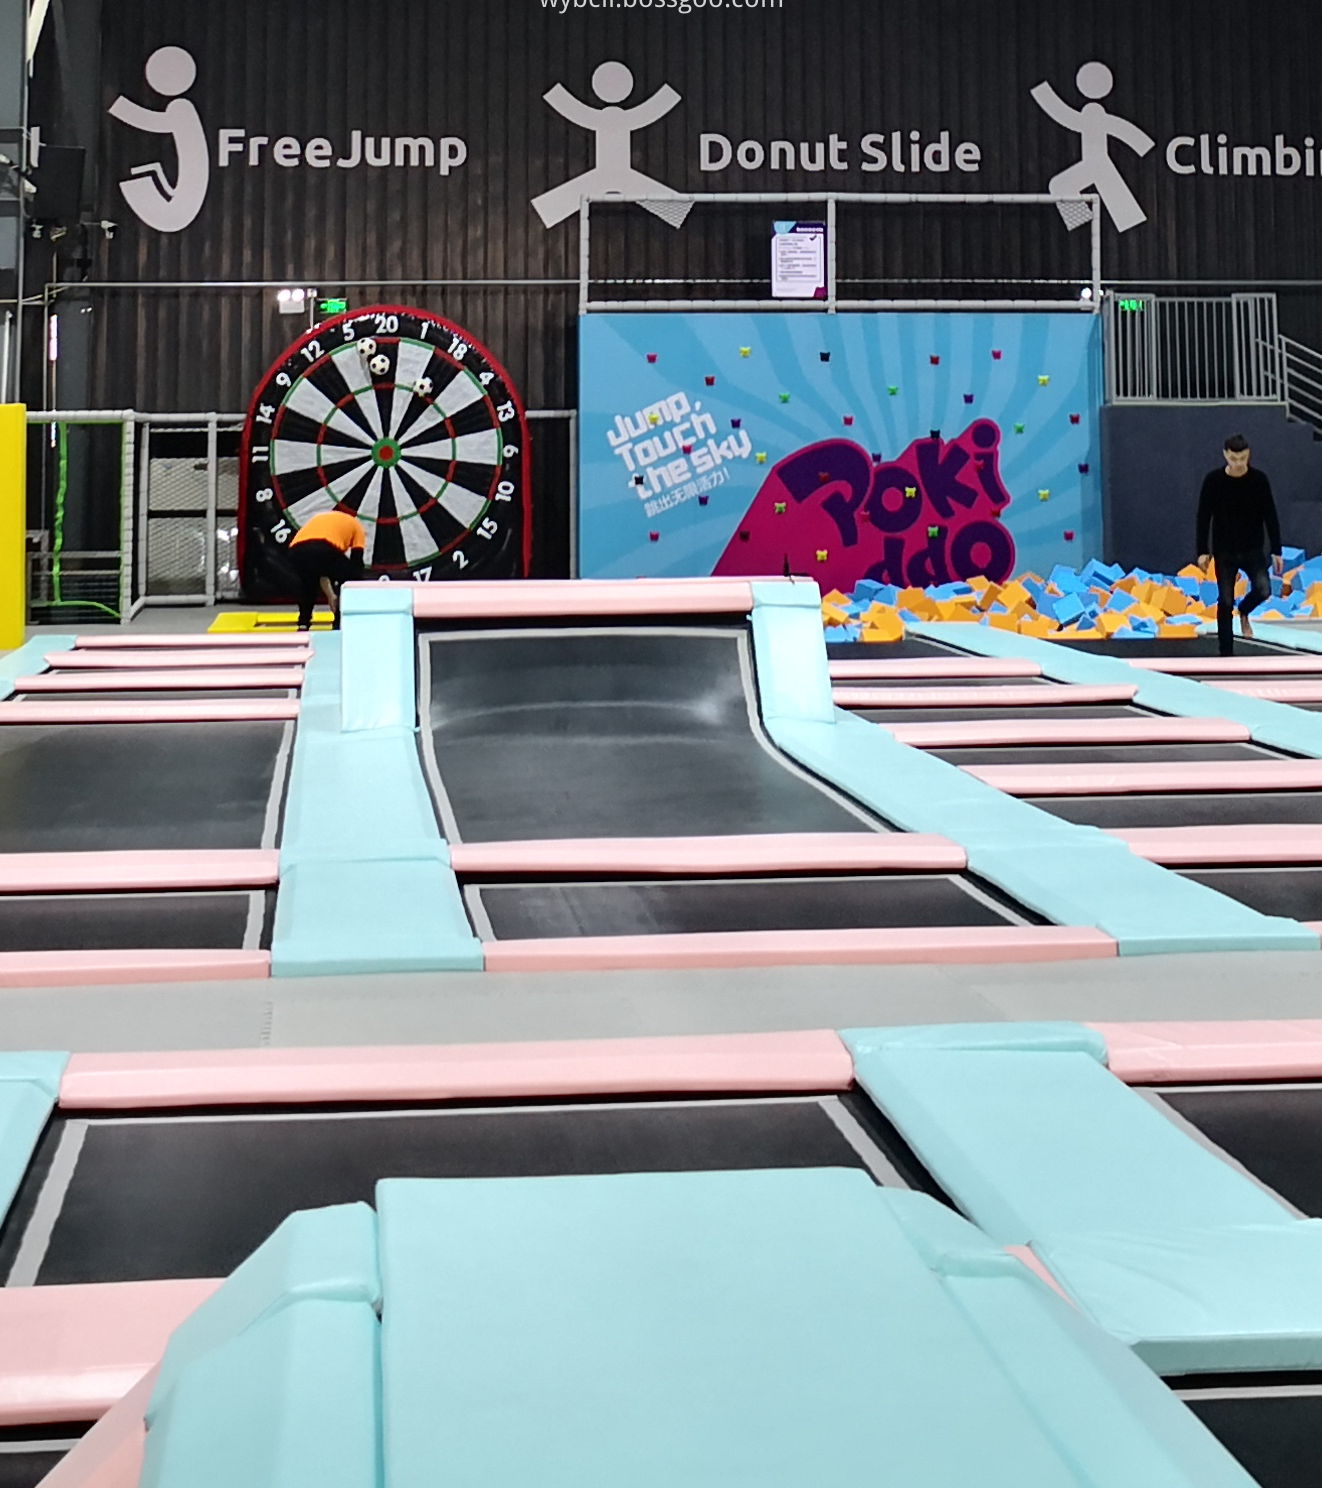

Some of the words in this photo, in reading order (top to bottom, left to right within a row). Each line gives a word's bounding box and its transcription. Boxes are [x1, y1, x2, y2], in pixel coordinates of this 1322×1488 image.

[698, 132, 850, 172] Donut
[859, 129, 982, 173] Slide
[342, 323, 355, 341] 5
[374, 314, 399, 333] 20
[420, 321, 431, 339] 1
[300, 340, 325, 363] 12
[447, 334, 468, 361] 18
[479, 371, 495, 387] 4
[255, 403, 275, 424] 14
[496, 400, 515, 422] 13
[252, 446, 269, 463] 11
[255, 488, 274, 502] 8
[494, 481, 515, 502] 10
[476, 518, 498, 540] 15
[452, 550, 469, 570] 2
